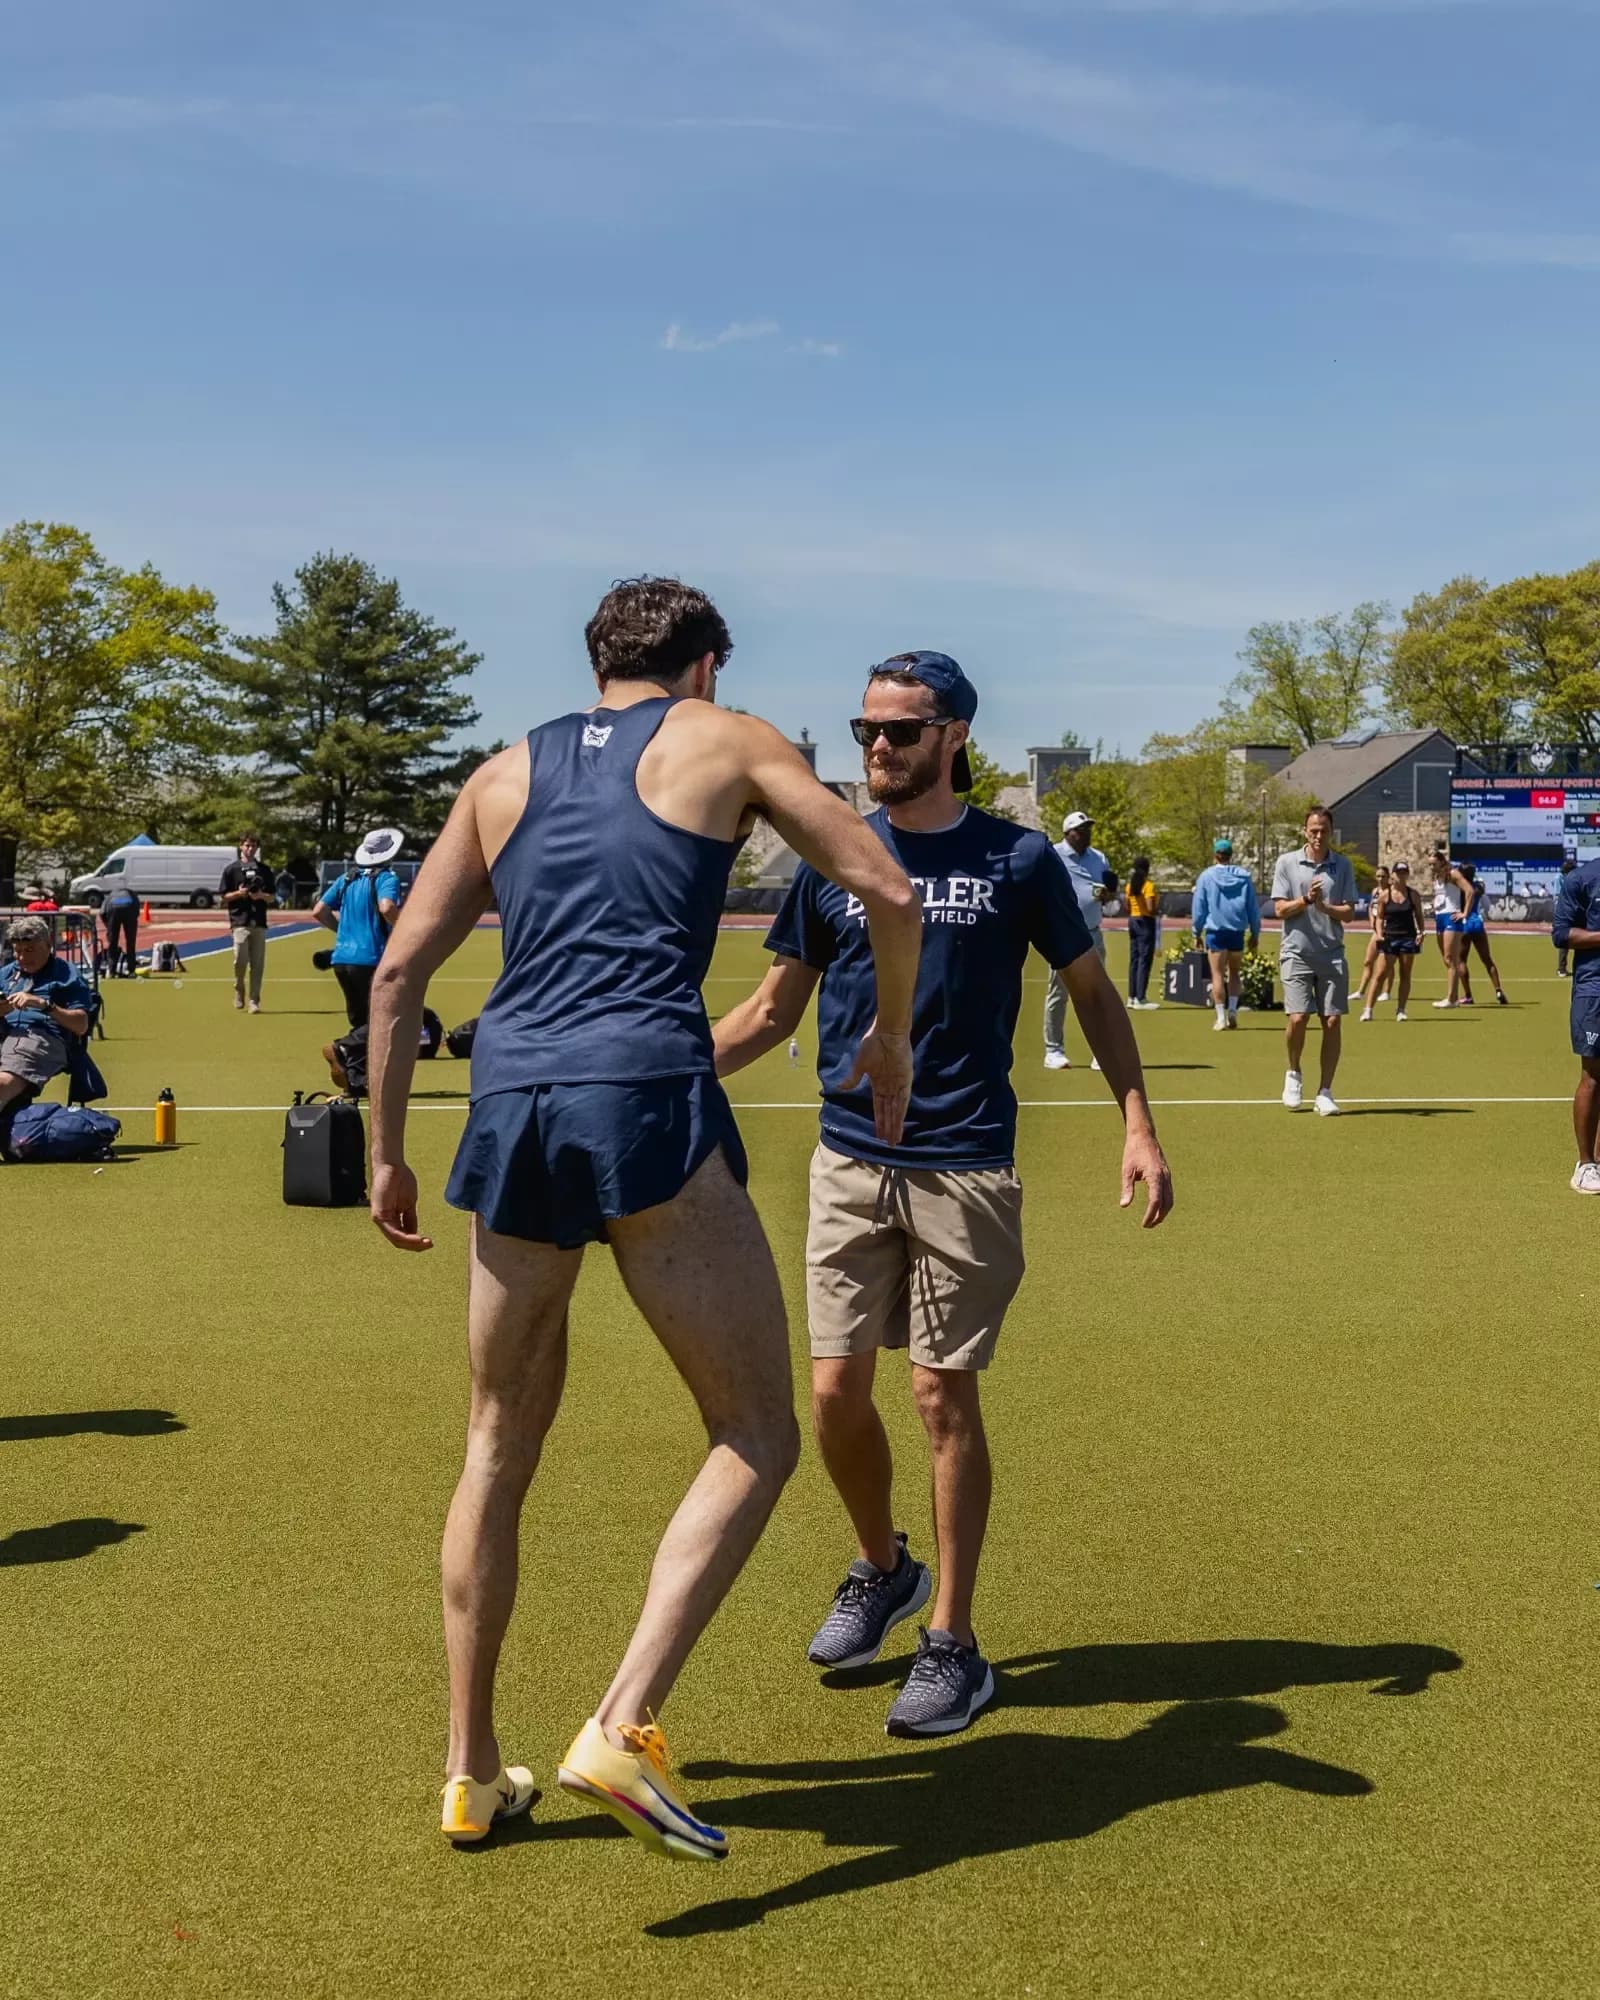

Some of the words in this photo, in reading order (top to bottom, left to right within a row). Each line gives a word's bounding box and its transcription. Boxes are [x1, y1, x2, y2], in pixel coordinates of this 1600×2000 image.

[845, 877, 996, 917] BLER
[931, 910, 977, 925] FIELD
[1169, 970, 1177, 994] 2
